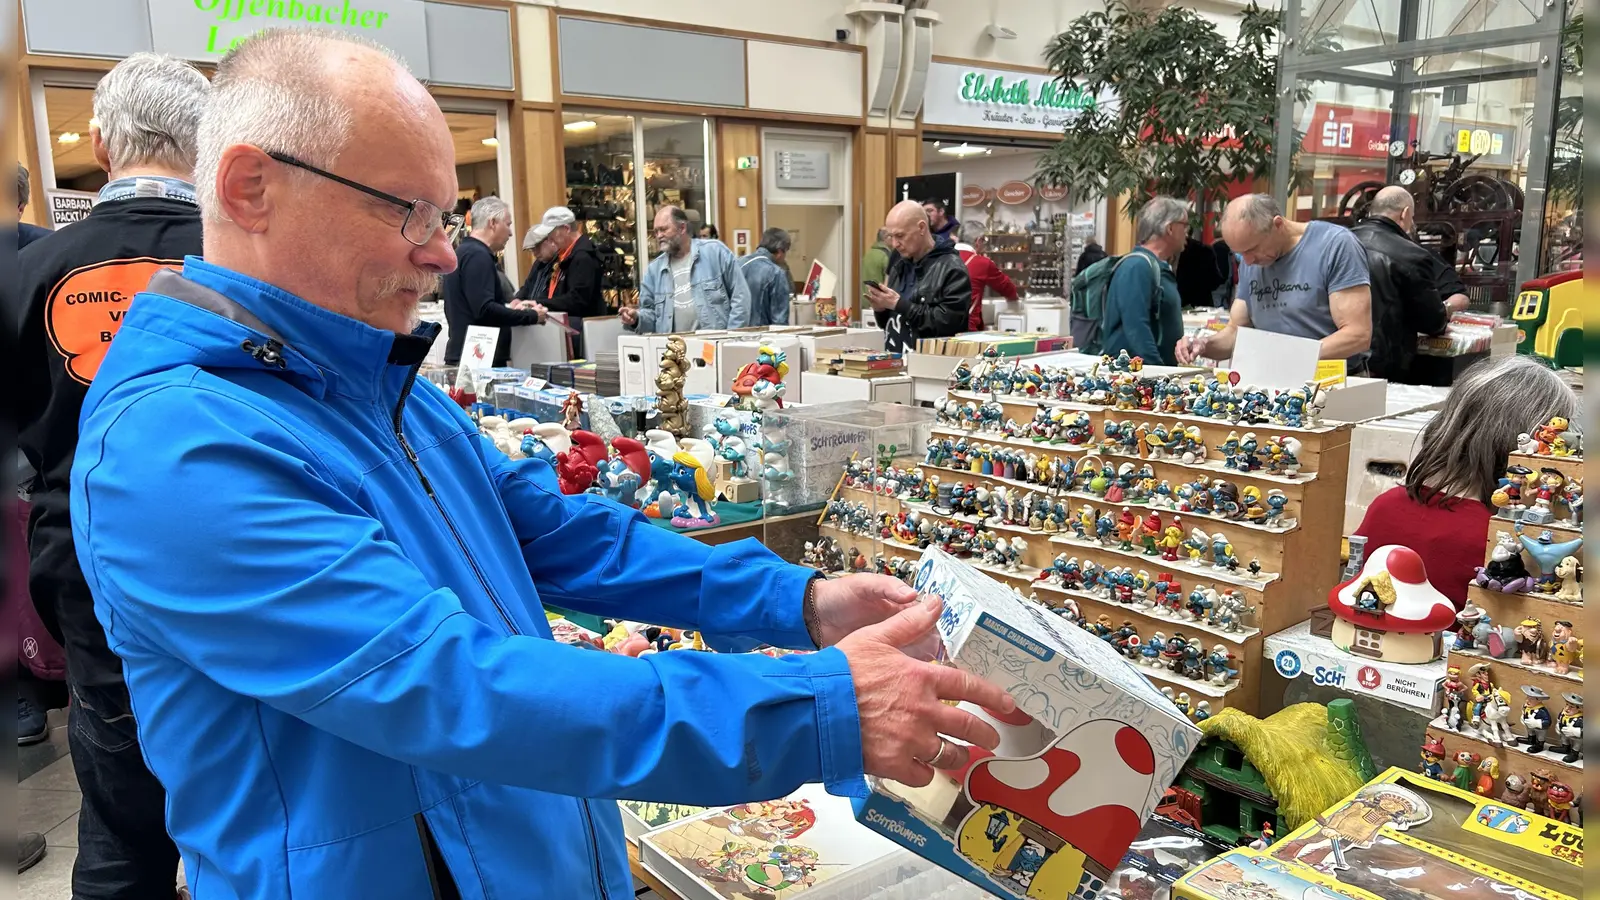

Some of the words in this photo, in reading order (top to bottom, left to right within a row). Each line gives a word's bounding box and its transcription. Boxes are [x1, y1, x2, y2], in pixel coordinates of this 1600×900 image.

[961, 72, 1030, 105] Elsbeth
[55, 198, 92, 210] BARBARA
[55, 211, 79, 222] PACKT
[1272, 278, 1312, 300] Jeans
[65, 291, 128, 305] COMIC-
[983, 617, 1009, 636] MAISON
[1006, 630, 1048, 657] CHAMPIGNON
[1283, 658, 1293, 668] 28
[1362, 680, 1376, 688] STOP
[1394, 678, 1417, 688] NICHT
[1386, 683, 1426, 698] BERÜHREN
[865, 808, 927, 847] SCHTROUMPFS
